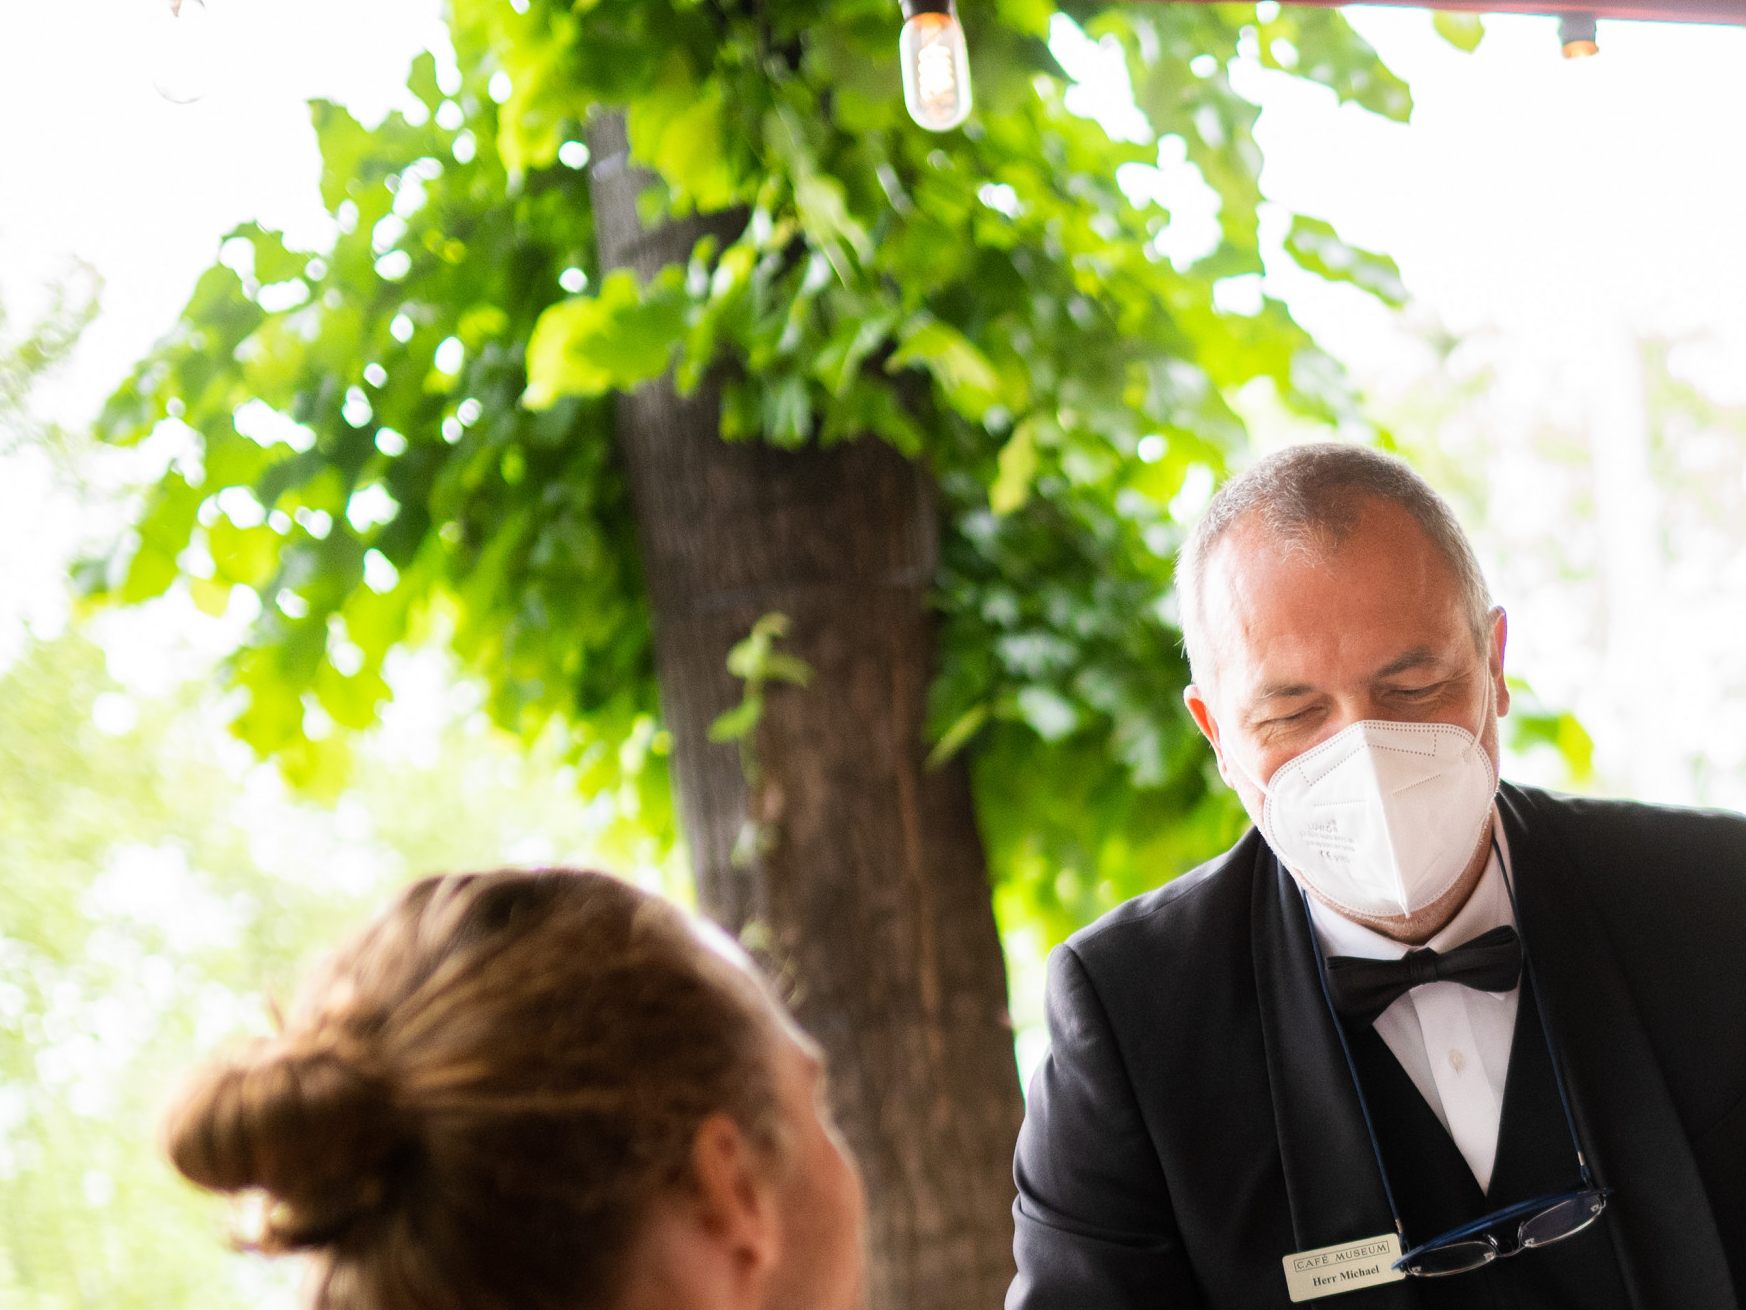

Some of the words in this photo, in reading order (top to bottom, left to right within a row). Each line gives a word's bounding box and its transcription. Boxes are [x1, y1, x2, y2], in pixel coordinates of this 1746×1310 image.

[1296, 1254, 1328, 1270] CAFÉ
[1335, 1244, 1386, 1262] MUSEUM
[1313, 1274, 1336, 1287] Herr
[1340, 1264, 1380, 1281] Michael
